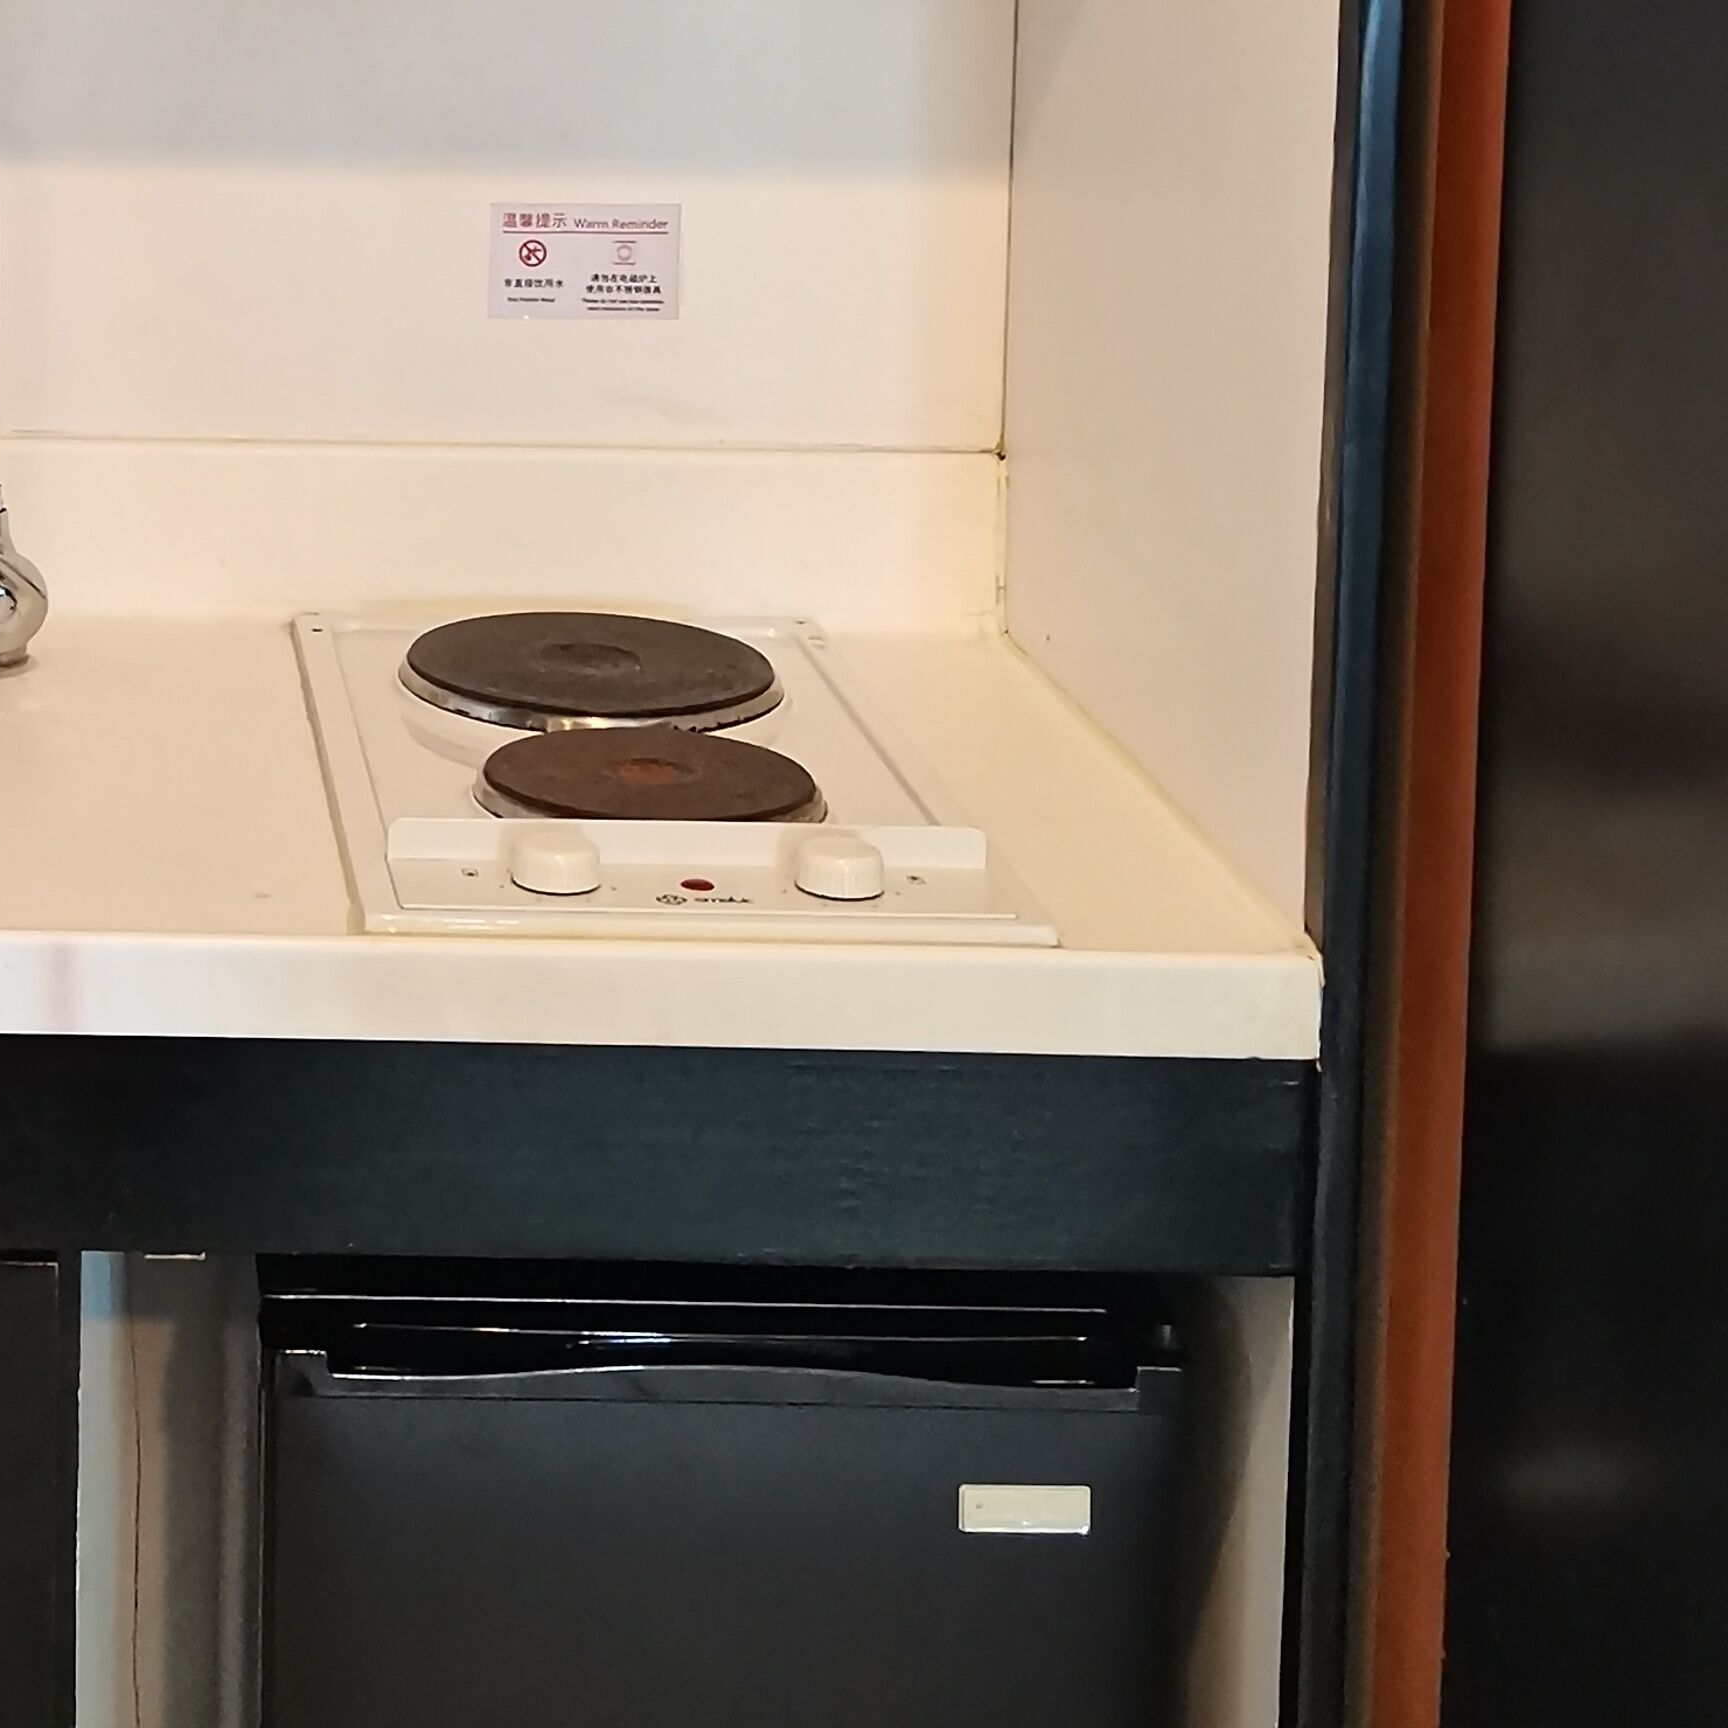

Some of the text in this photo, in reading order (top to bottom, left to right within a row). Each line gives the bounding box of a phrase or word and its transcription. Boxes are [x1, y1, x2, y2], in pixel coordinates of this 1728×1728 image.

[502, 212, 567, 229] 温馨提示
[574, 218, 669, 230] Warm Reminder
